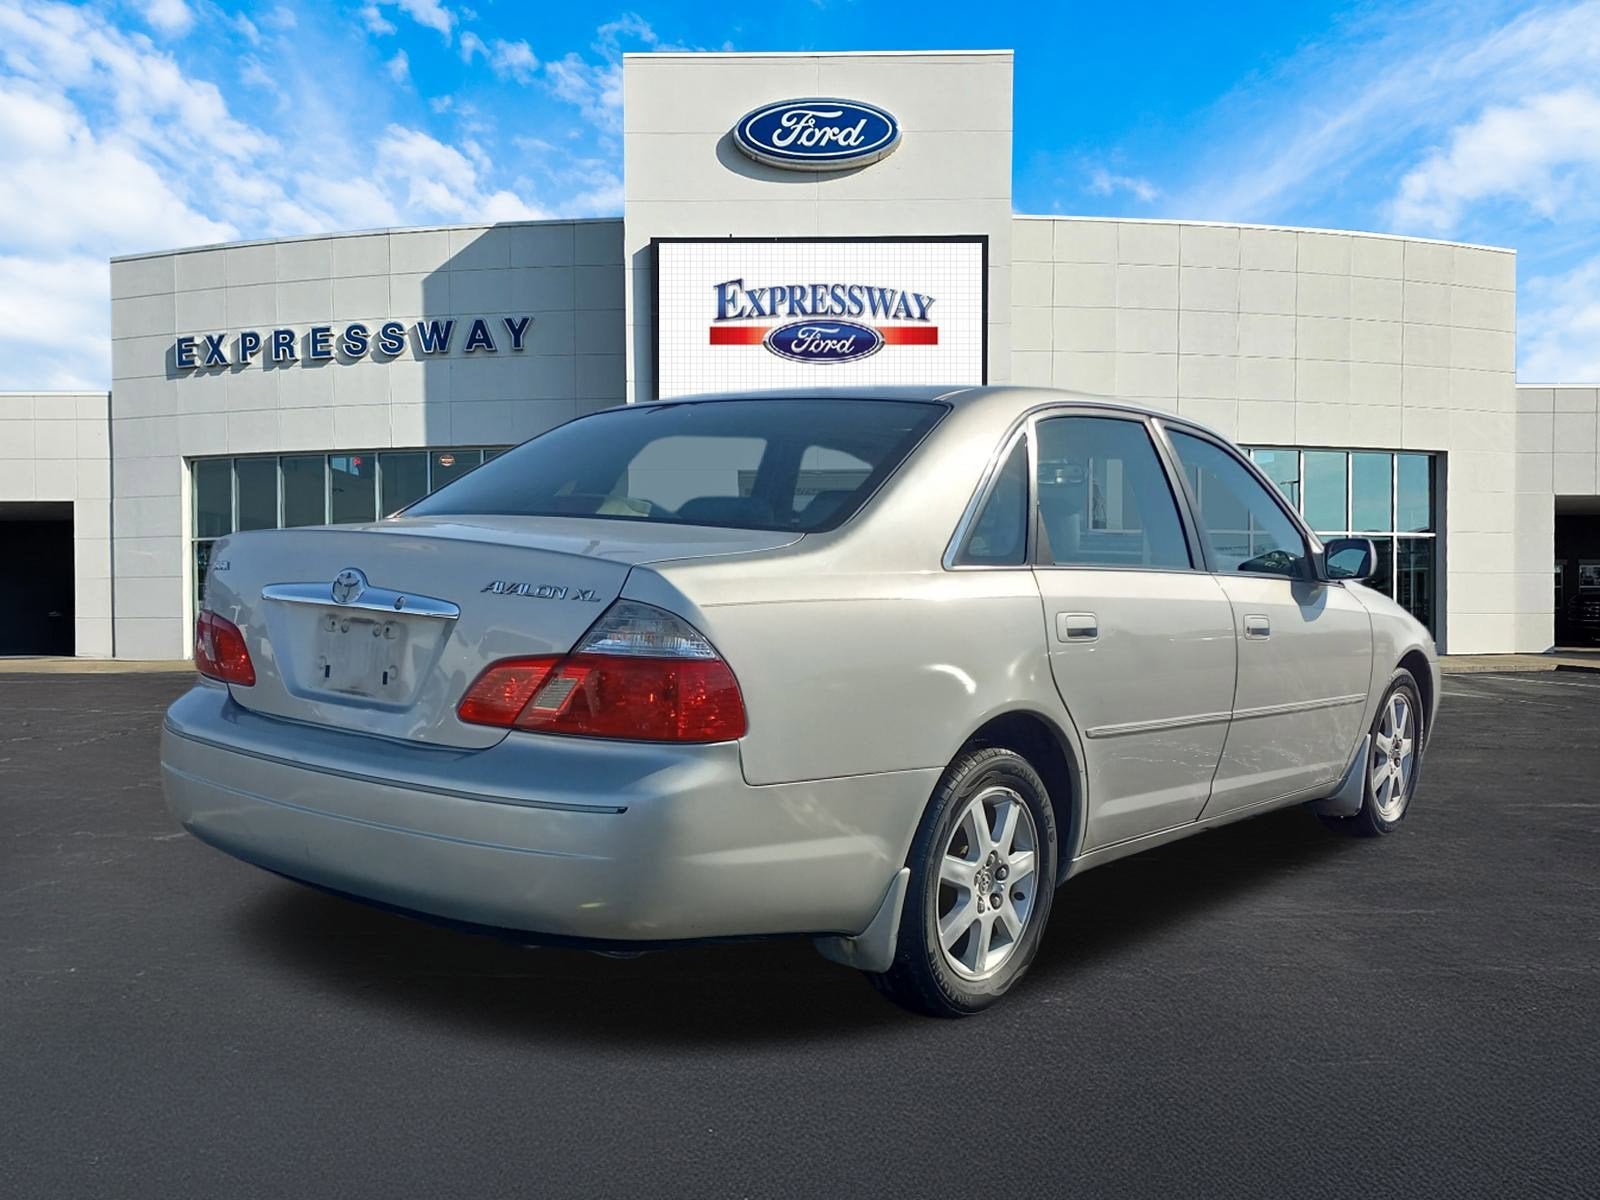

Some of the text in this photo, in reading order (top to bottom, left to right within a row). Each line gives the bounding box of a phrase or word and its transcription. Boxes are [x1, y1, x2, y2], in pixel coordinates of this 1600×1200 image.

[772, 109, 867, 148] Ford
[712, 278, 936, 322] EXPRESSWAY
[175, 315, 533, 369] EXPRESSWAY
[791, 326, 855, 354] Ford
[480, 580, 602, 603] AVALON XL
